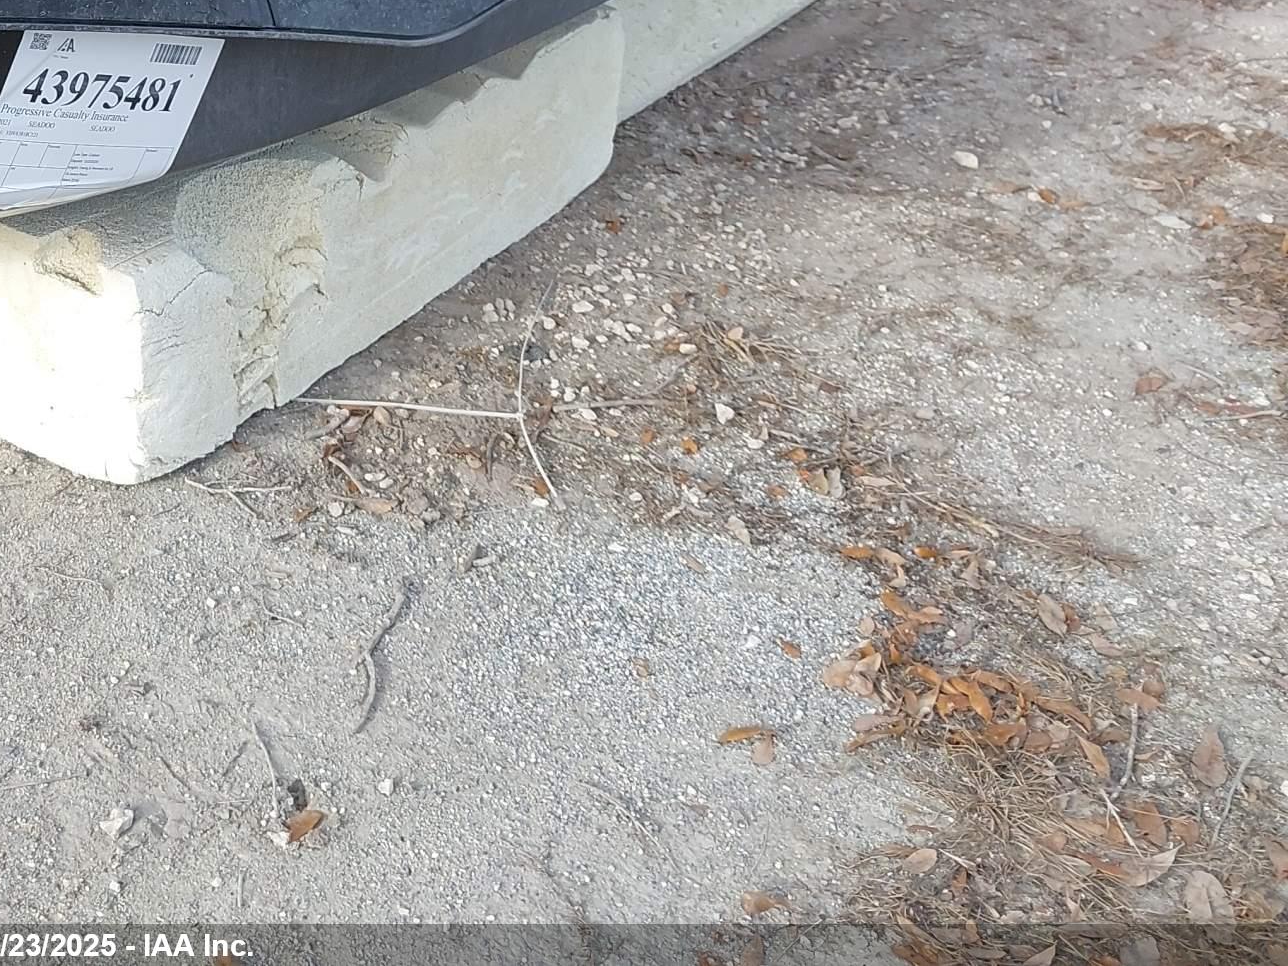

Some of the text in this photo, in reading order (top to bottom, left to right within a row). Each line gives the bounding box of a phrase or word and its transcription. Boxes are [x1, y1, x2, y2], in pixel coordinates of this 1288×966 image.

[22, 68, 182, 112] 43975481
[0, 103, 129, 122] Progressive Casualty Insurance
[28, 120, 56, 129] SEADOO
